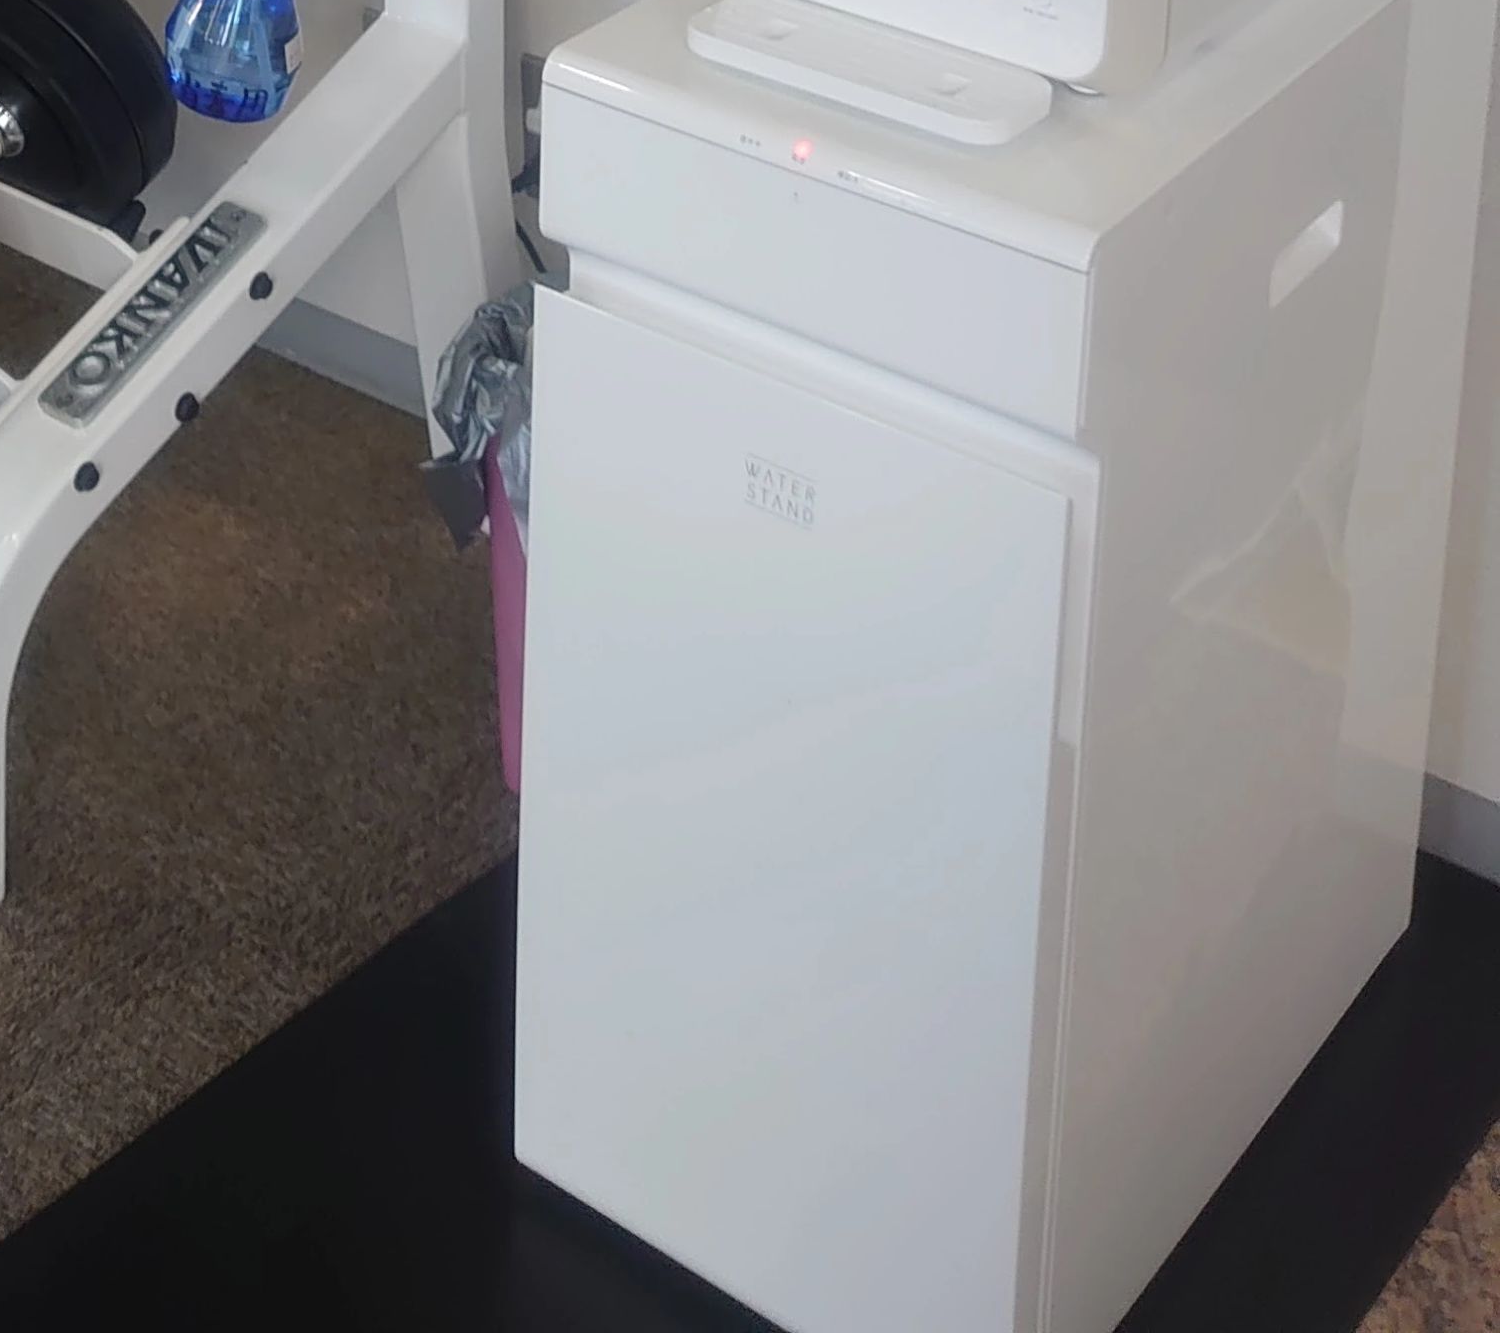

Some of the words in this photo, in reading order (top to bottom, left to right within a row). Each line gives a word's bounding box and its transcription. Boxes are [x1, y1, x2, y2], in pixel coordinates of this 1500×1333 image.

[67, 215, 233, 387] IVANKO
[744, 459, 816, 503] WATER
[746, 483, 813, 525] STAND
